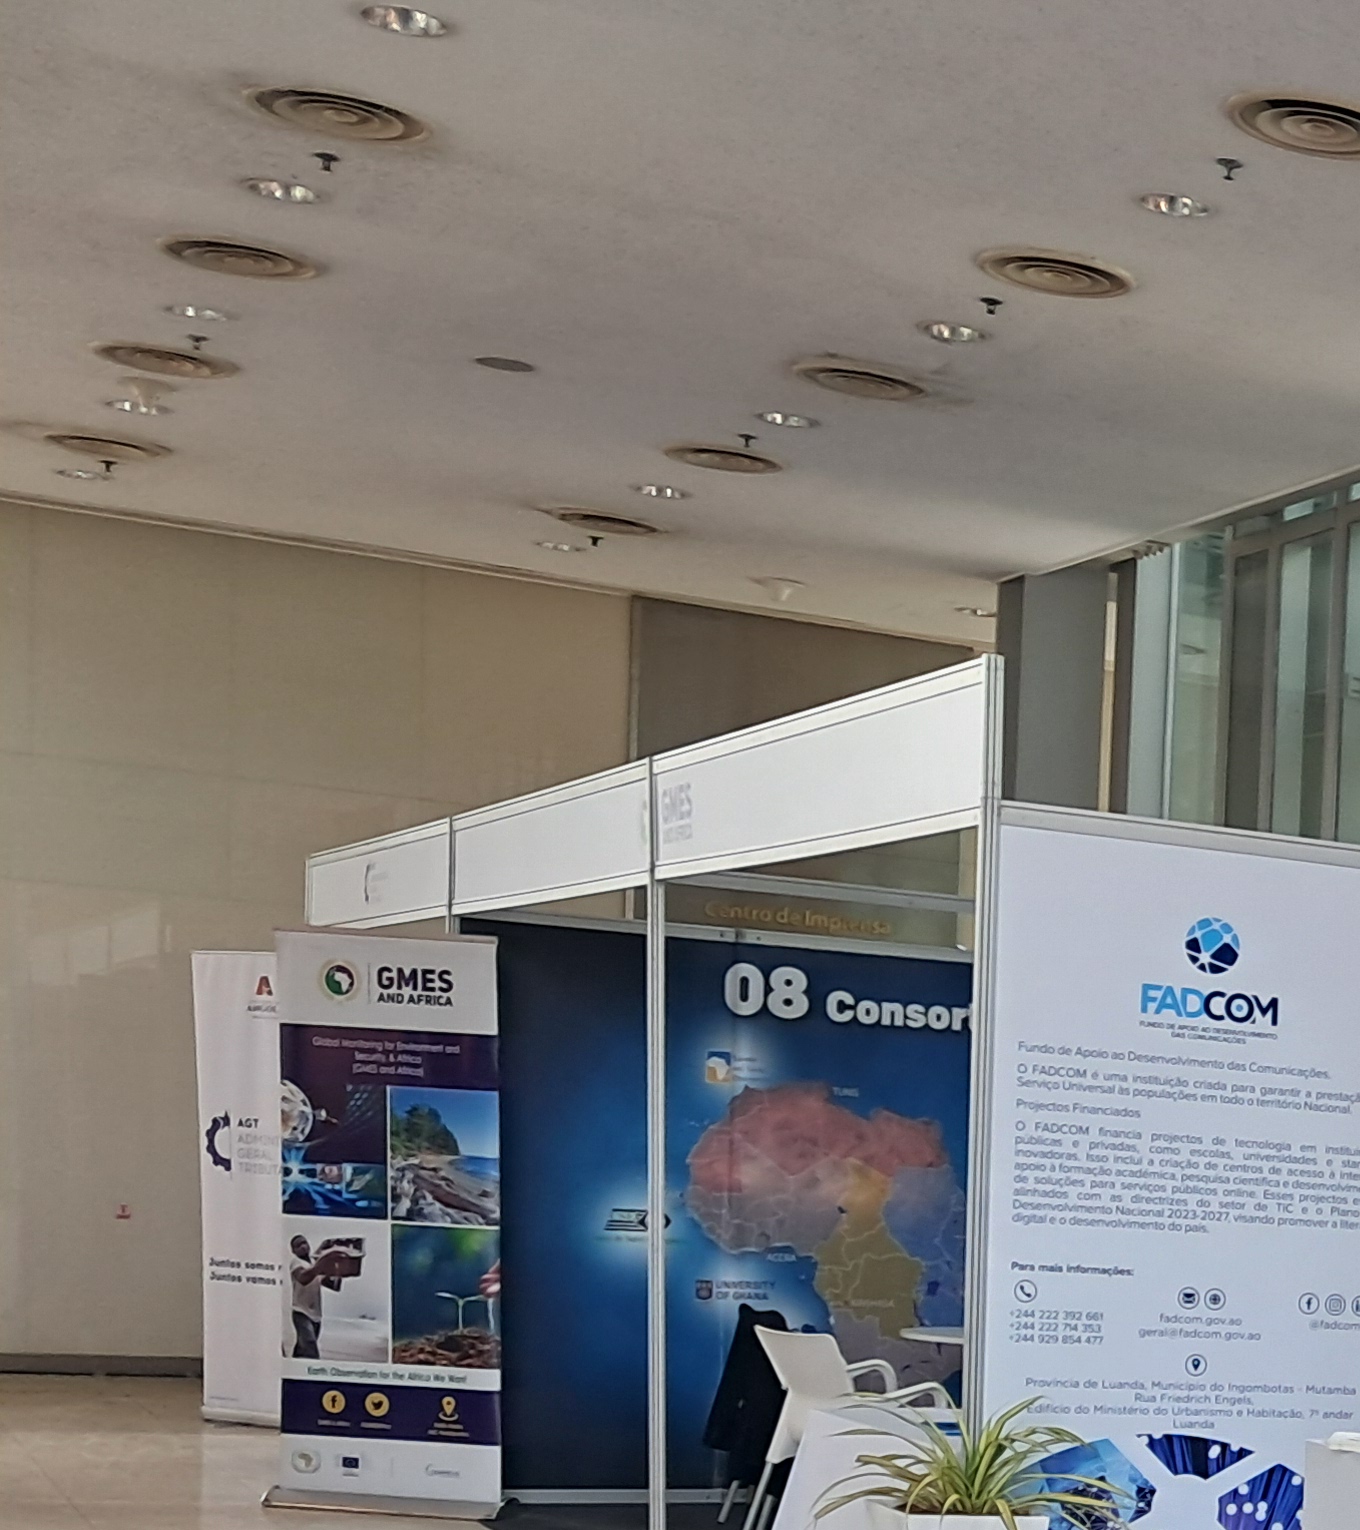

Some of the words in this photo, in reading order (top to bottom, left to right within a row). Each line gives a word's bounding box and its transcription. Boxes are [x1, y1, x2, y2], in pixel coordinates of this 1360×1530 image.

[376, 966, 454, 993] GMES
[376, 993, 404, 1004] AND
[406, 994, 454, 1007] AFRICA
[724, 962, 810, 1020] 08
[1140, 983, 1279, 1026] FADCOM
[1015, 1099, 1070, 1114] Projectos
[1072, 1104, 1141, 1118] Financiados
[237, 1118, 259, 1128] AGT
[1172, 1419, 1214, 1429] Luanda
